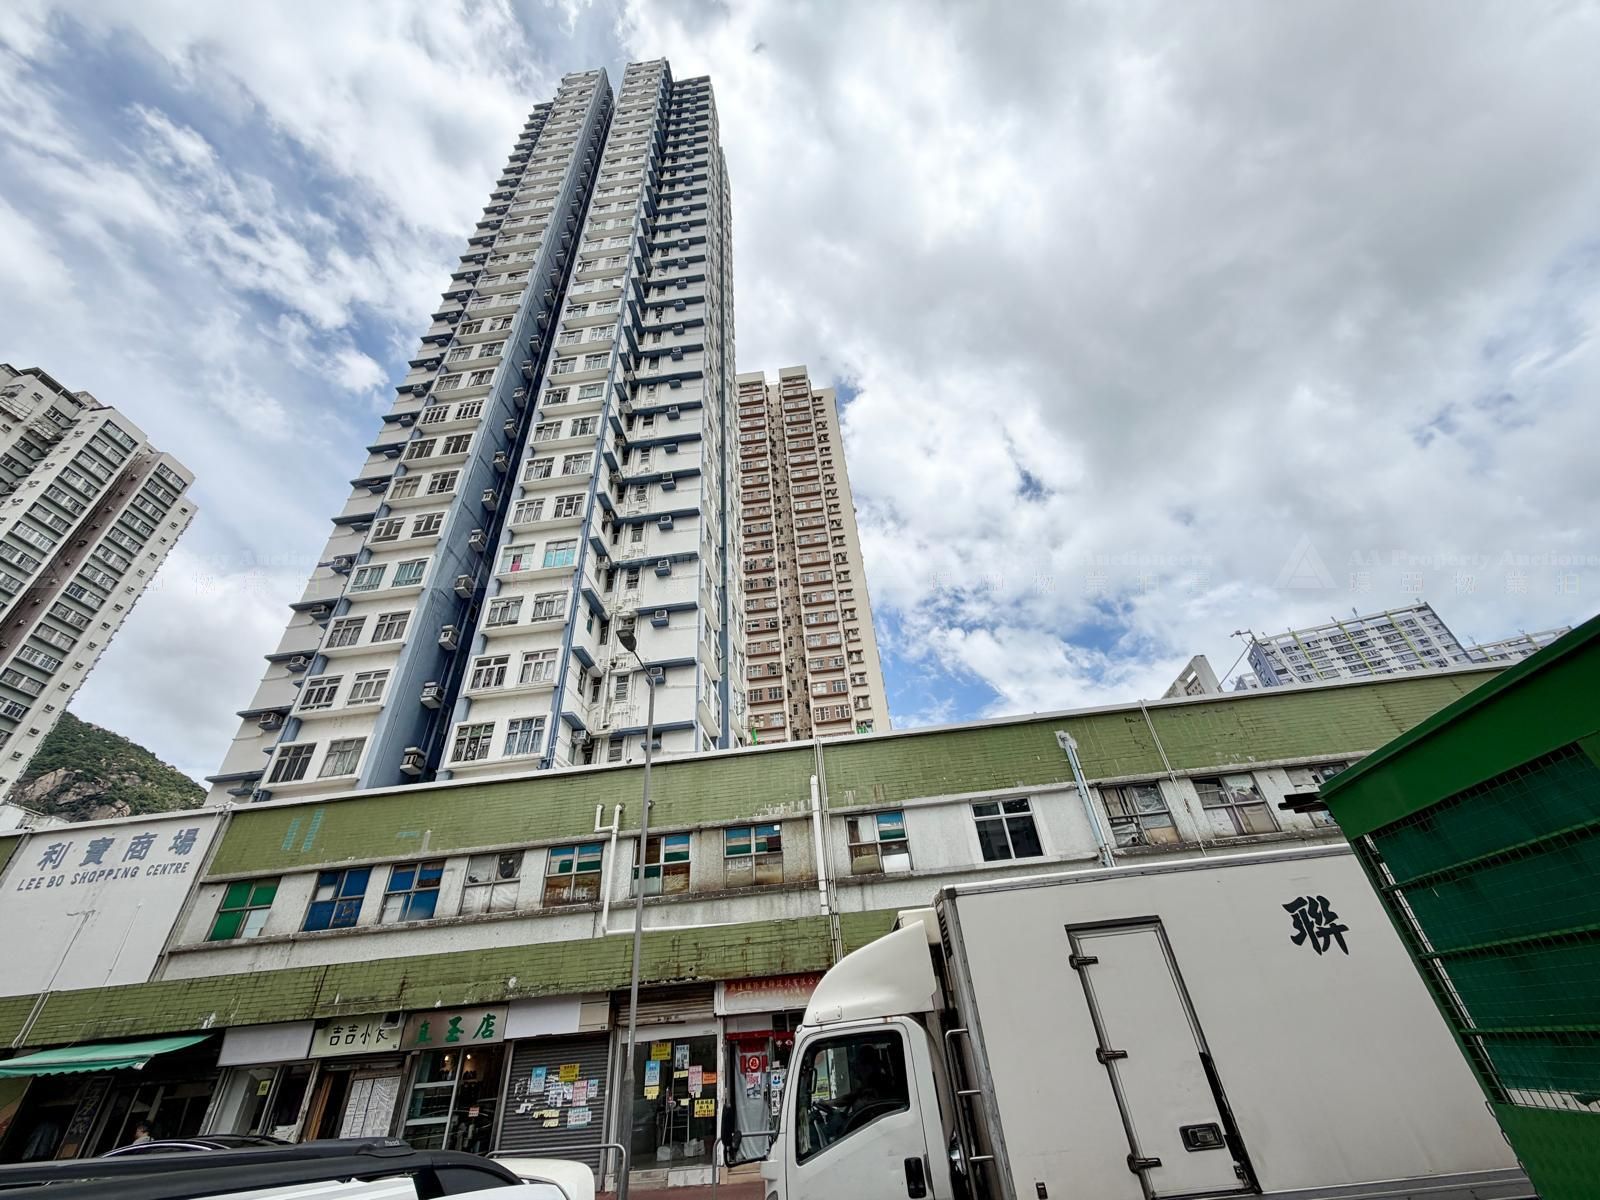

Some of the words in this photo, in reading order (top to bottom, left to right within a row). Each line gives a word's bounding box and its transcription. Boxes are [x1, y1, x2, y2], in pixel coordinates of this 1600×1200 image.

[17, 877, 44, 892] LEE
[48, 875, 65, 888] BO
[70, 866, 140, 886] SHOPPING
[146, 862, 190, 877] CENTRE
[1281, 895, 1350, 956] 聯
